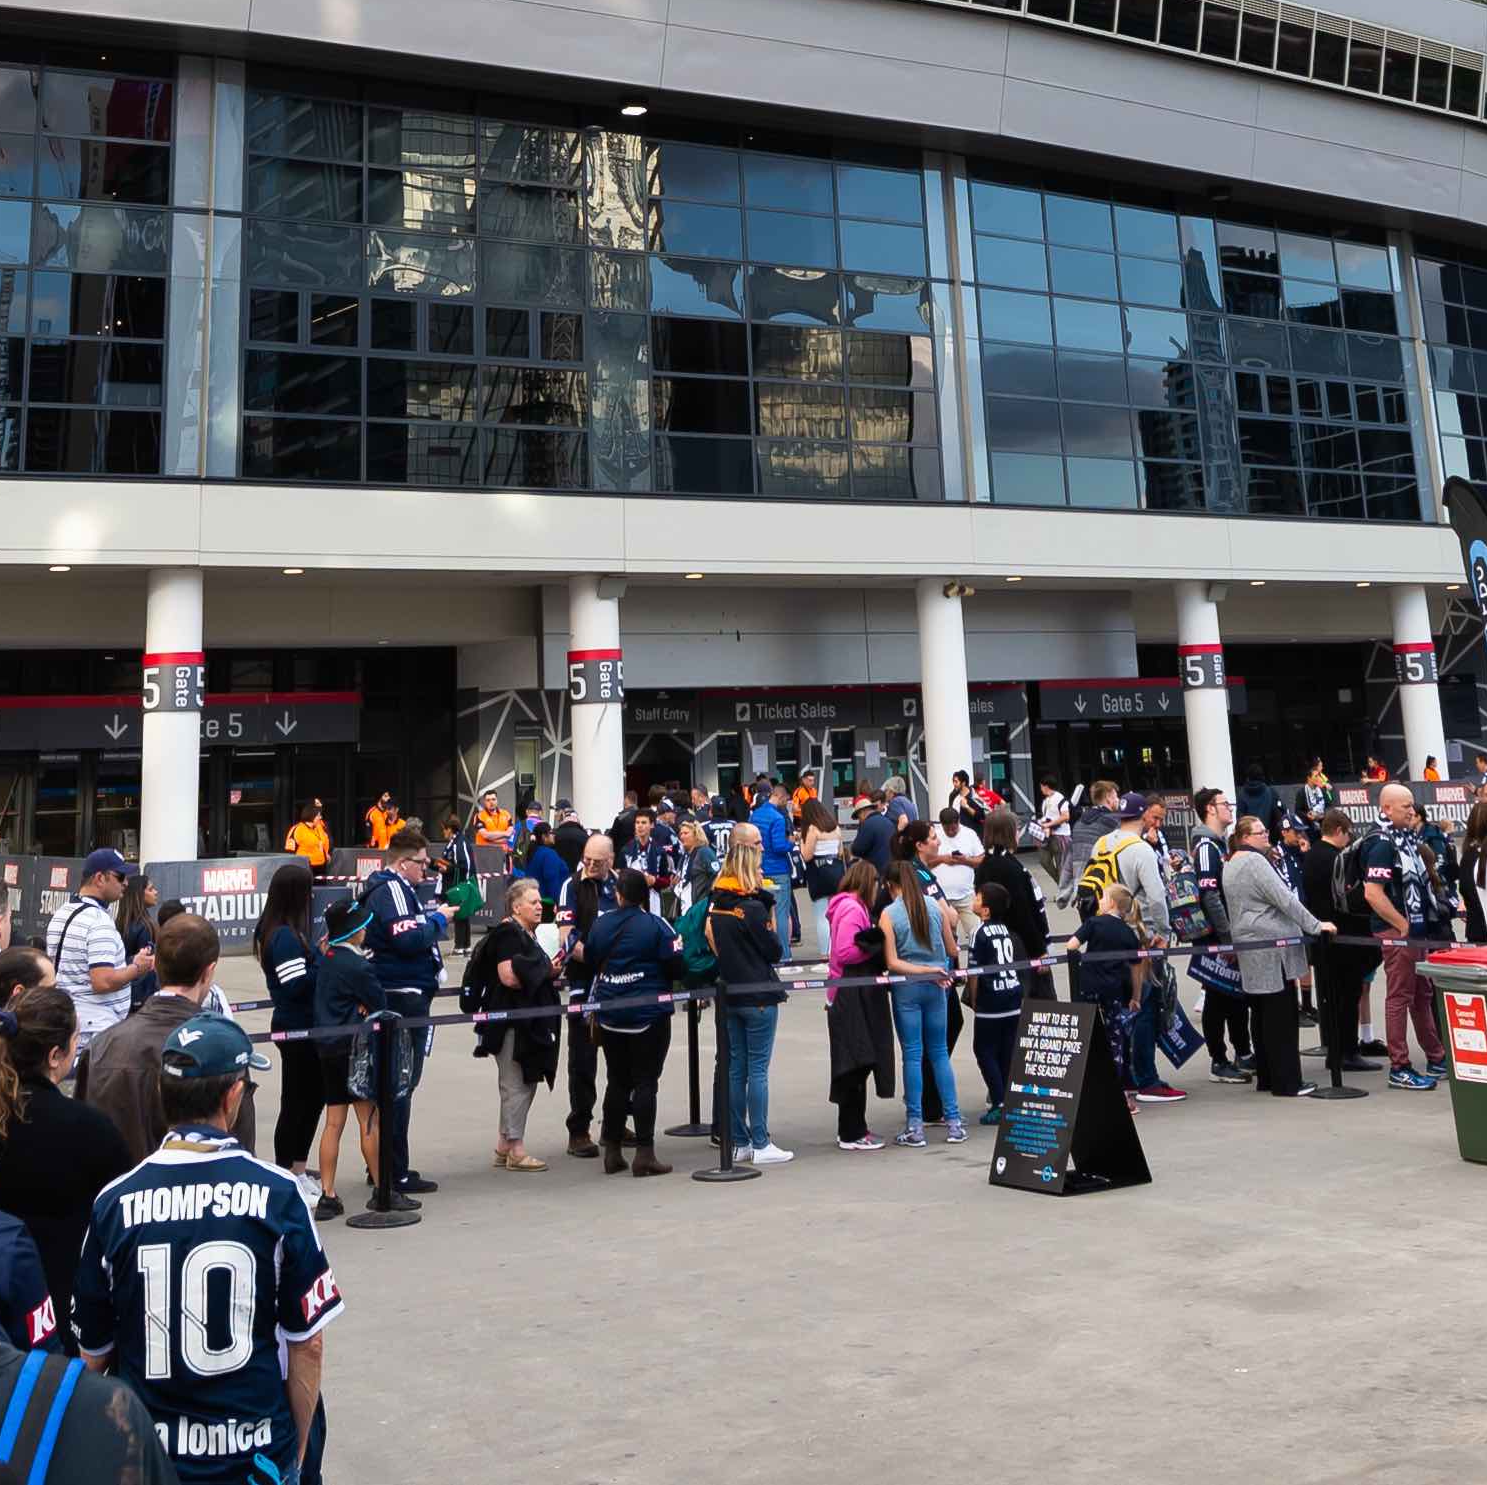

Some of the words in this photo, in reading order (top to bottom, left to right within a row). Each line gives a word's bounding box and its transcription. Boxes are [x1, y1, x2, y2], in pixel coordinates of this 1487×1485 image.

[1184, 655, 1205, 686] 5
[1405, 652, 1426, 681] 5
[142, 667, 161, 709] 5
[175, 666, 190, 708] Gate
[569, 663, 587, 700] 5
[599, 661, 612, 699] Gate
[755, 702, 797, 720] Ticket
[800, 701, 837, 719] Sales
[969, 698, 994, 714] ales
[1102, 694, 1131, 714] Gate
[1134, 693, 1144, 713] 5
[228, 713, 243, 738] 5
[635, 708, 661, 722] Staff
[663, 708, 690, 723] Entry
[1339, 789, 1369, 805] MARVEL
[1436, 787, 1465, 803] MARVEL
[203, 868, 255, 894] MARVEL
[1367, 867, 1393, 879] KFC
[392, 919, 418, 936] KFC
[992, 937, 1014, 965] 10
[1032, 1012, 1051, 1024] WANT
[1052, 1013, 1060, 1025] TO
[1060, 1014, 1070, 1026] BE
[1071, 1015, 1079, 1027] IN
[1027, 1024, 1040, 1037] THE
[1040, 1025, 1069, 1039] RUNNING
[1070, 1027, 1079, 1040] TO
[1019, 1036, 1033, 1049] WIN
[1040, 1038, 1062, 1052] GRAND
[1062, 1040, 1083, 1054] PRIZE
[1024, 1050, 1033, 1062] AT
[1034, 1051, 1046, 1064] THE
[1047, 1052, 1061, 1065] END
[1062, 1054, 1072, 1066] OF
[1024, 1063, 1037, 1076] THE
[1037, 1064, 1068, 1078] SEASON?
[119, 1181, 271, 1229] THOMPSON
[137, 1240, 257, 1380] 10
[177, 1416, 272, 1456] Ionica
